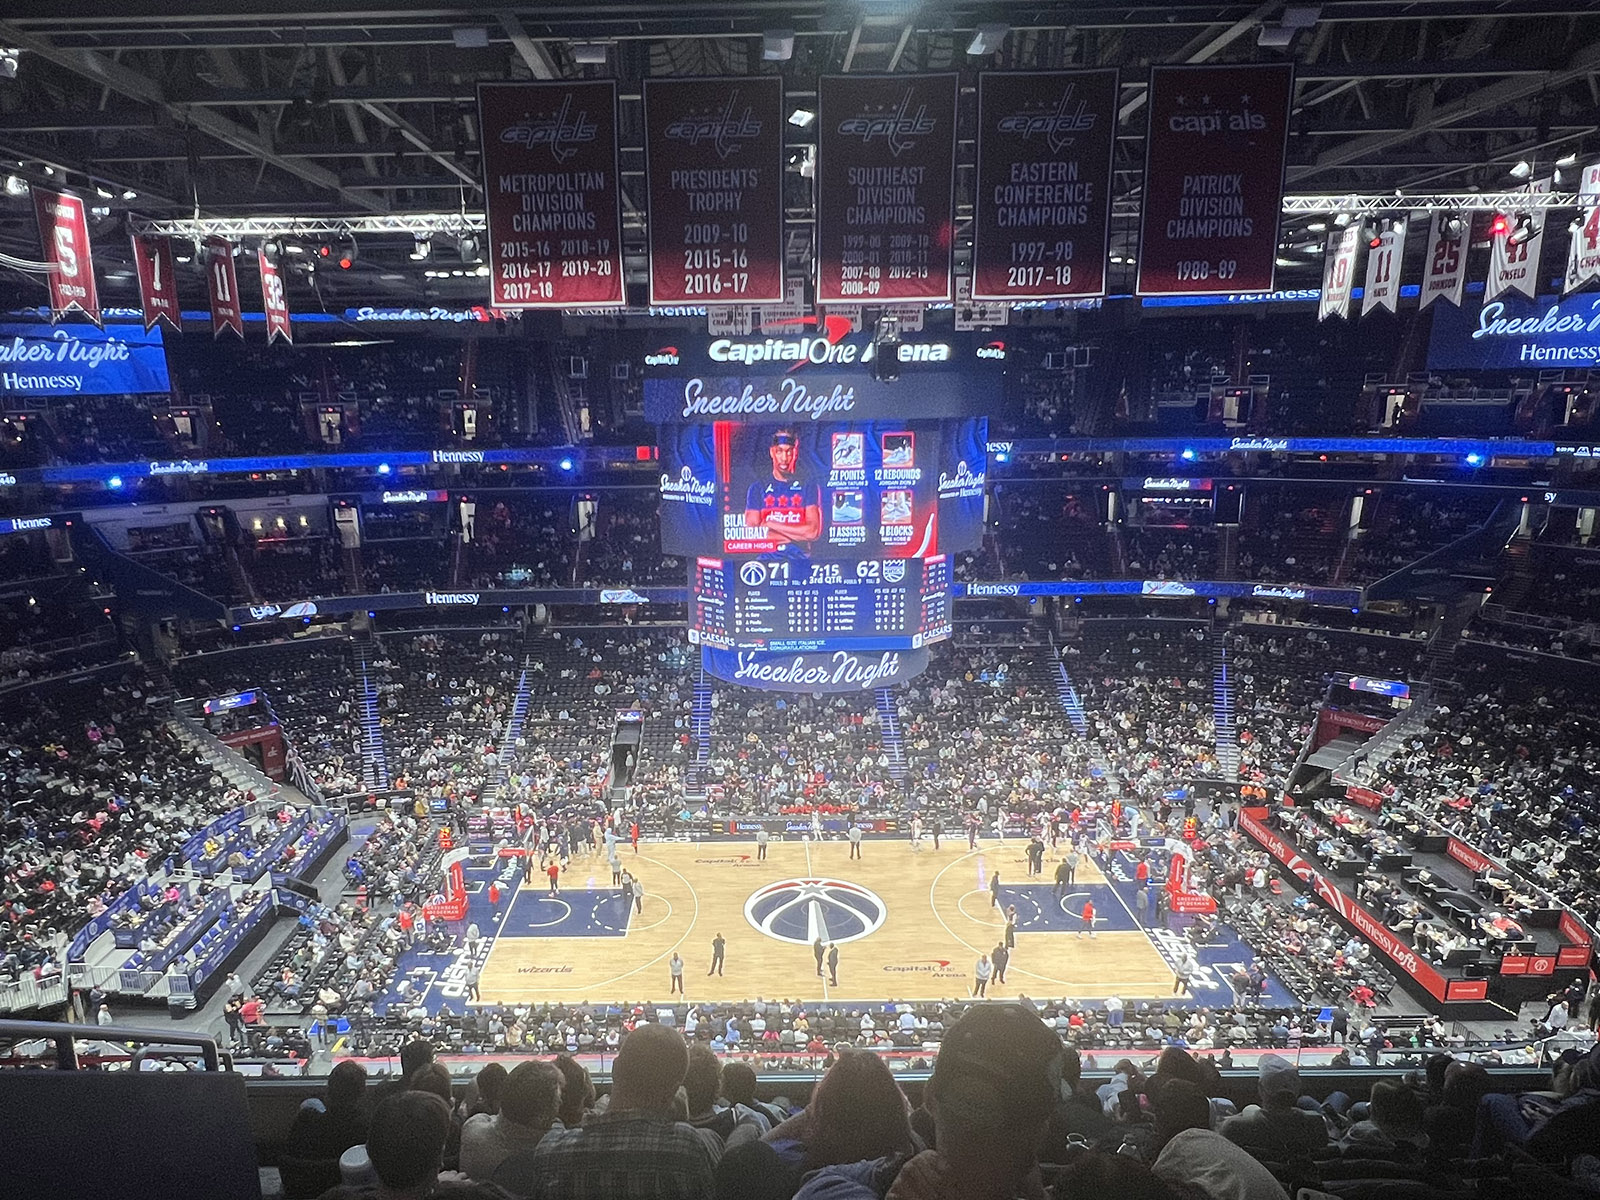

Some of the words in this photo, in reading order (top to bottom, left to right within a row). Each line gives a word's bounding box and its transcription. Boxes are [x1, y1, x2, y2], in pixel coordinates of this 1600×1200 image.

[1169, 109, 1266, 135] capials
[848, 167, 925, 186] SOUTHEAST
[1011, 162, 1078, 183] EASTERN
[500, 172, 604, 194] METROPOLITAN
[1183, 174, 1242, 195] PATRICK
[522, 193, 584, 212] DIVISION
[687, 192, 742, 211] TROPHY
[857, 187, 916, 205] DIVISION
[994, 182, 1093, 205] CONFERENCE
[847, 206, 925, 225] CHAMPIONS
[1180, 196, 1243, 216] DIVISION
[512, 212, 596, 233] CHAMPIONS
[997, 206, 1087, 227] CHAMPIONS
[684, 223, 747, 244] 2009-10
[1167, 218, 1253, 239] CHAMPIONS
[54, 225, 78, 277] 5
[501, 241, 550, 257] 2015-16
[1011, 241, 1073, 261] 1997-98
[1432, 239, 1462, 275] 25
[685, 249, 748, 269] 2015-16
[1375, 250, 1392, 283] 11
[502, 262, 551, 279] 2016-17
[562, 260, 611, 276] 2019-20
[841, 267, 880, 279] 2007-08
[889, 266, 928, 279] 2012-13
[1008, 267, 1071, 287] 2017-18
[214, 262, 231, 302] 11
[503, 282, 553, 299] 2017-18
[685, 273, 748, 294] 2016-17
[356, 306, 431, 322] Sneaker
[1472, 301, 1586, 339] Sneaker
[54, 330, 130, 368] Night
[860, 341, 950, 363] Aena
[3, 372, 83, 391] Hennessy
[682, 378, 780, 418] Sneaker
[779, 378, 855, 420] Night
[1230, 437, 1263, 450] Sneaker
[1262, 437, 1287, 451] Night
[432, 450, 485, 463] Hennessy
[150, 462, 182, 475] Sneaker
[829, 469, 839, 481] 27
[840, 469, 866, 480] POINTS
[874, 469, 882, 480] 12
[883, 468, 921, 480] REBOUNDS
[659, 473, 690, 492] Sneaker
[937, 472, 965, 492] Sneaker
[1143, 477, 1170, 489] Sneaker
[723, 526, 769, 540] COULIBALY
[836, 526, 866, 537] ASSISTS
[885, 525, 913, 537] BLOCKS
[768, 562, 789, 579] 71
[810, 564, 839, 577] 7:15
[856, 560, 880, 577] 62
[808, 576, 823, 585] 3rd
[825, 575, 842, 584] QTR
[967, 582, 1021, 596] Hennessy
[426, 592, 480, 606] Hennessy
[1252, 585, 1282, 597] Sneaker
[700, 631, 735, 647] CAESARS
[922, 623, 953, 640] CAESARS
[734, 651, 831, 684] Sneaker
[830, 651, 900, 688] Night
[1240, 810, 1268, 844] Hennessy
[1268, 837, 1285, 858] Lofts
[1449, 841, 1480, 869] Hennessy
[1351, 905, 1394, 952] Hennessy
[1393, 945, 1418, 974] Lofts
[517, 964, 574, 973] wizards
